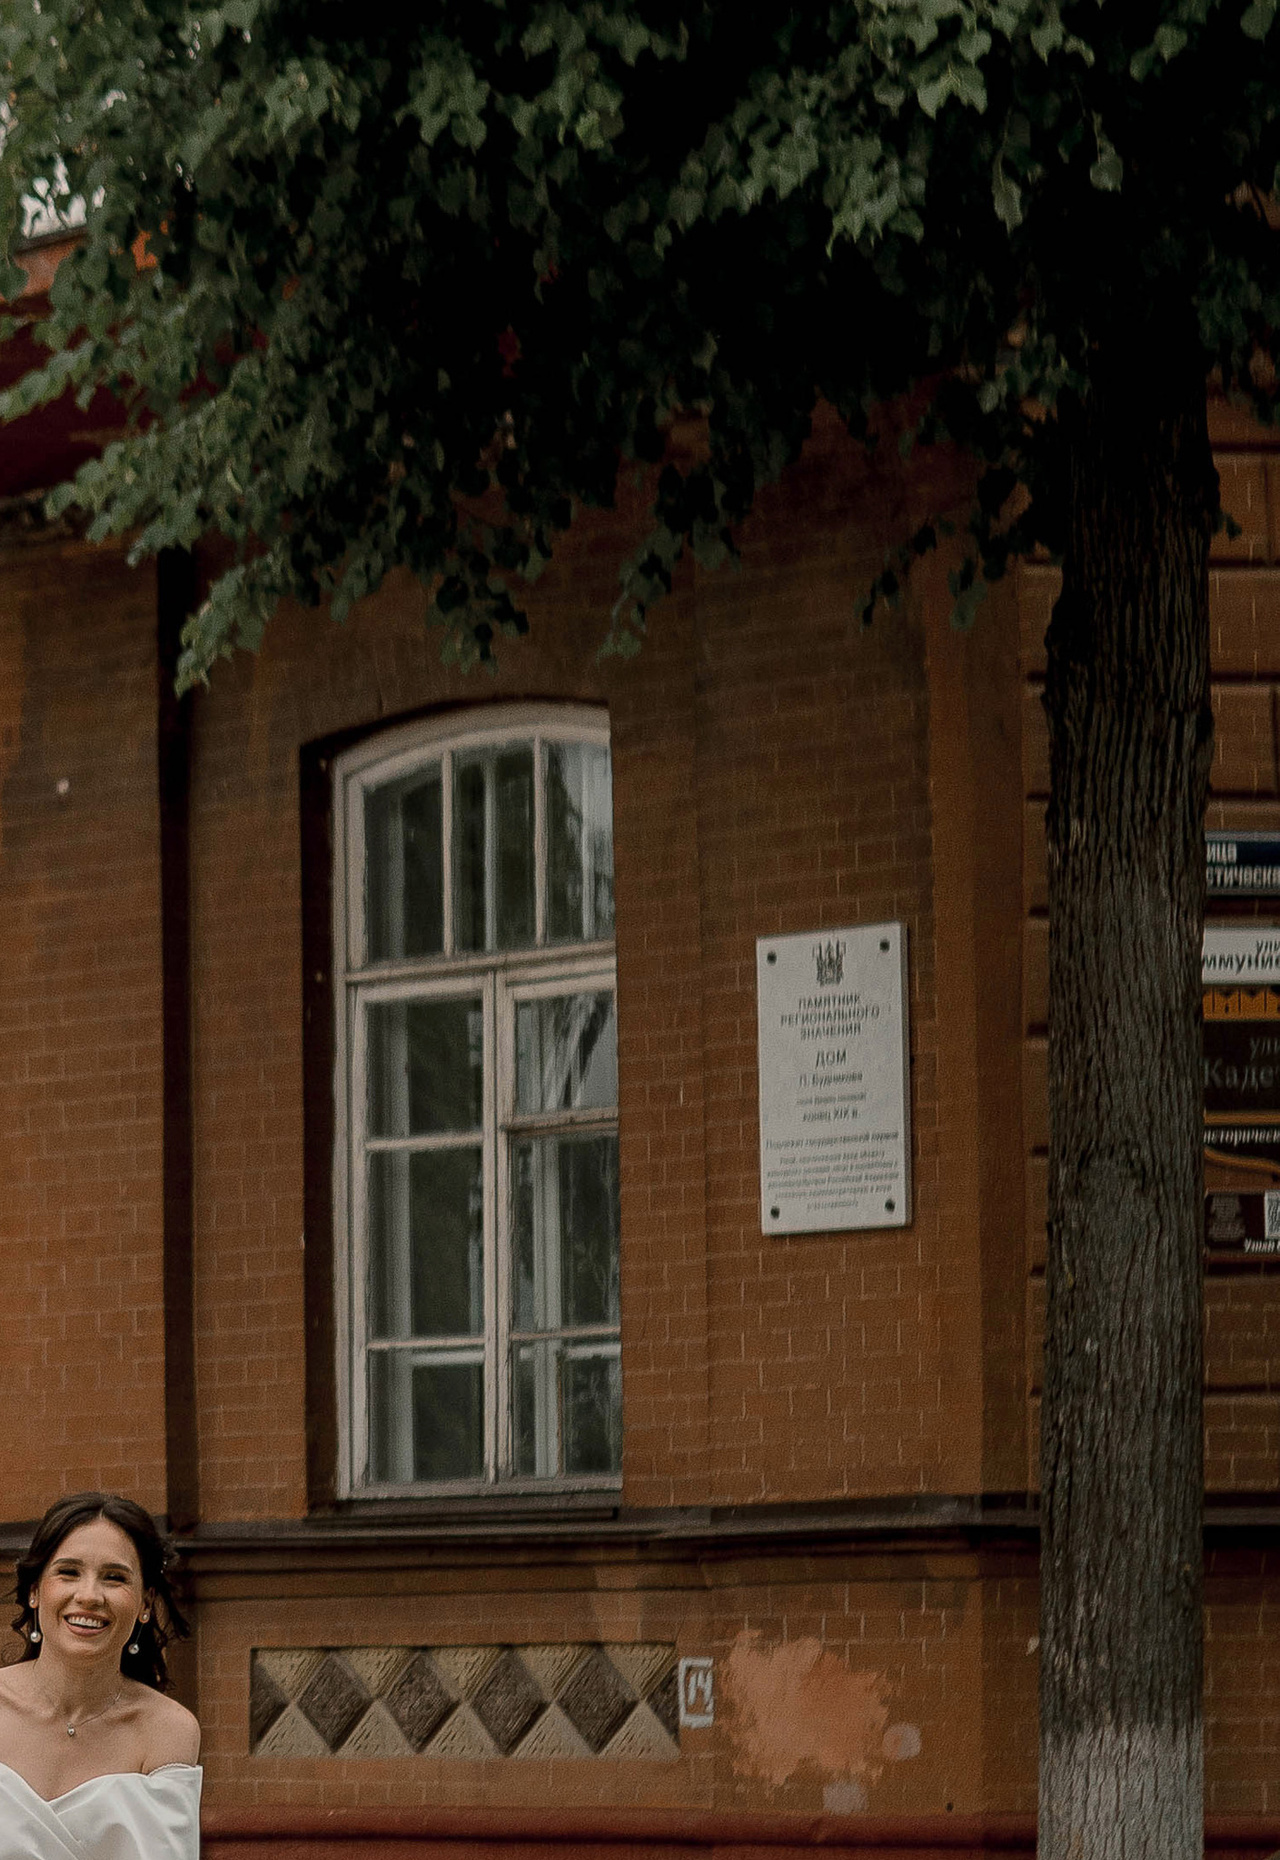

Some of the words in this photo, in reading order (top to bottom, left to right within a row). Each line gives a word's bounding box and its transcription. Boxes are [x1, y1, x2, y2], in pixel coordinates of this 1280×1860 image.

[798, 991, 861, 1010] ПАМЯТНИК
[780, 1003, 880, 1025] РЕГИОНАЛЬНОГО
[815, 1048, 847, 1069] ДОМ
